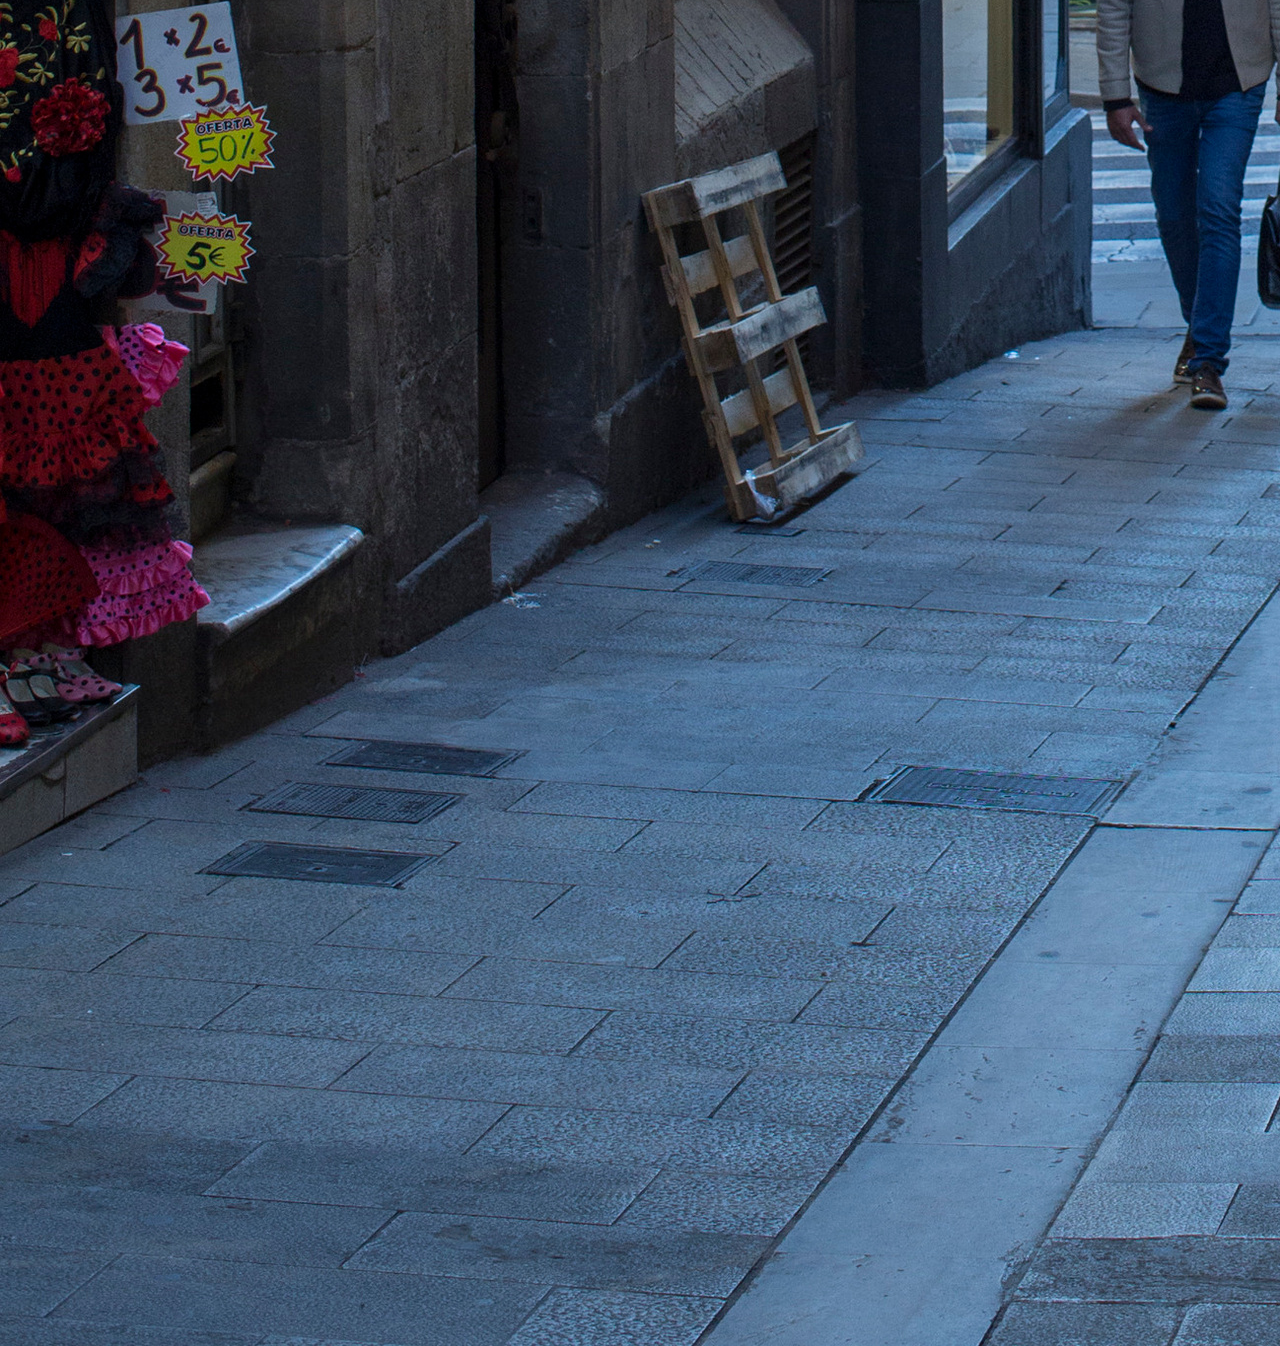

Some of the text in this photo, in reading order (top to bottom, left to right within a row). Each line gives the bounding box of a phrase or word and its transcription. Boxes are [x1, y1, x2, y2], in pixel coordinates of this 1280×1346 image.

[134, 67, 167, 118] 3
[195, 116, 254, 136] OFERTA
[198, 131, 256, 165] 50%
[178, 223, 237, 241] OFERTA
[185, 241, 227, 272] 5€
